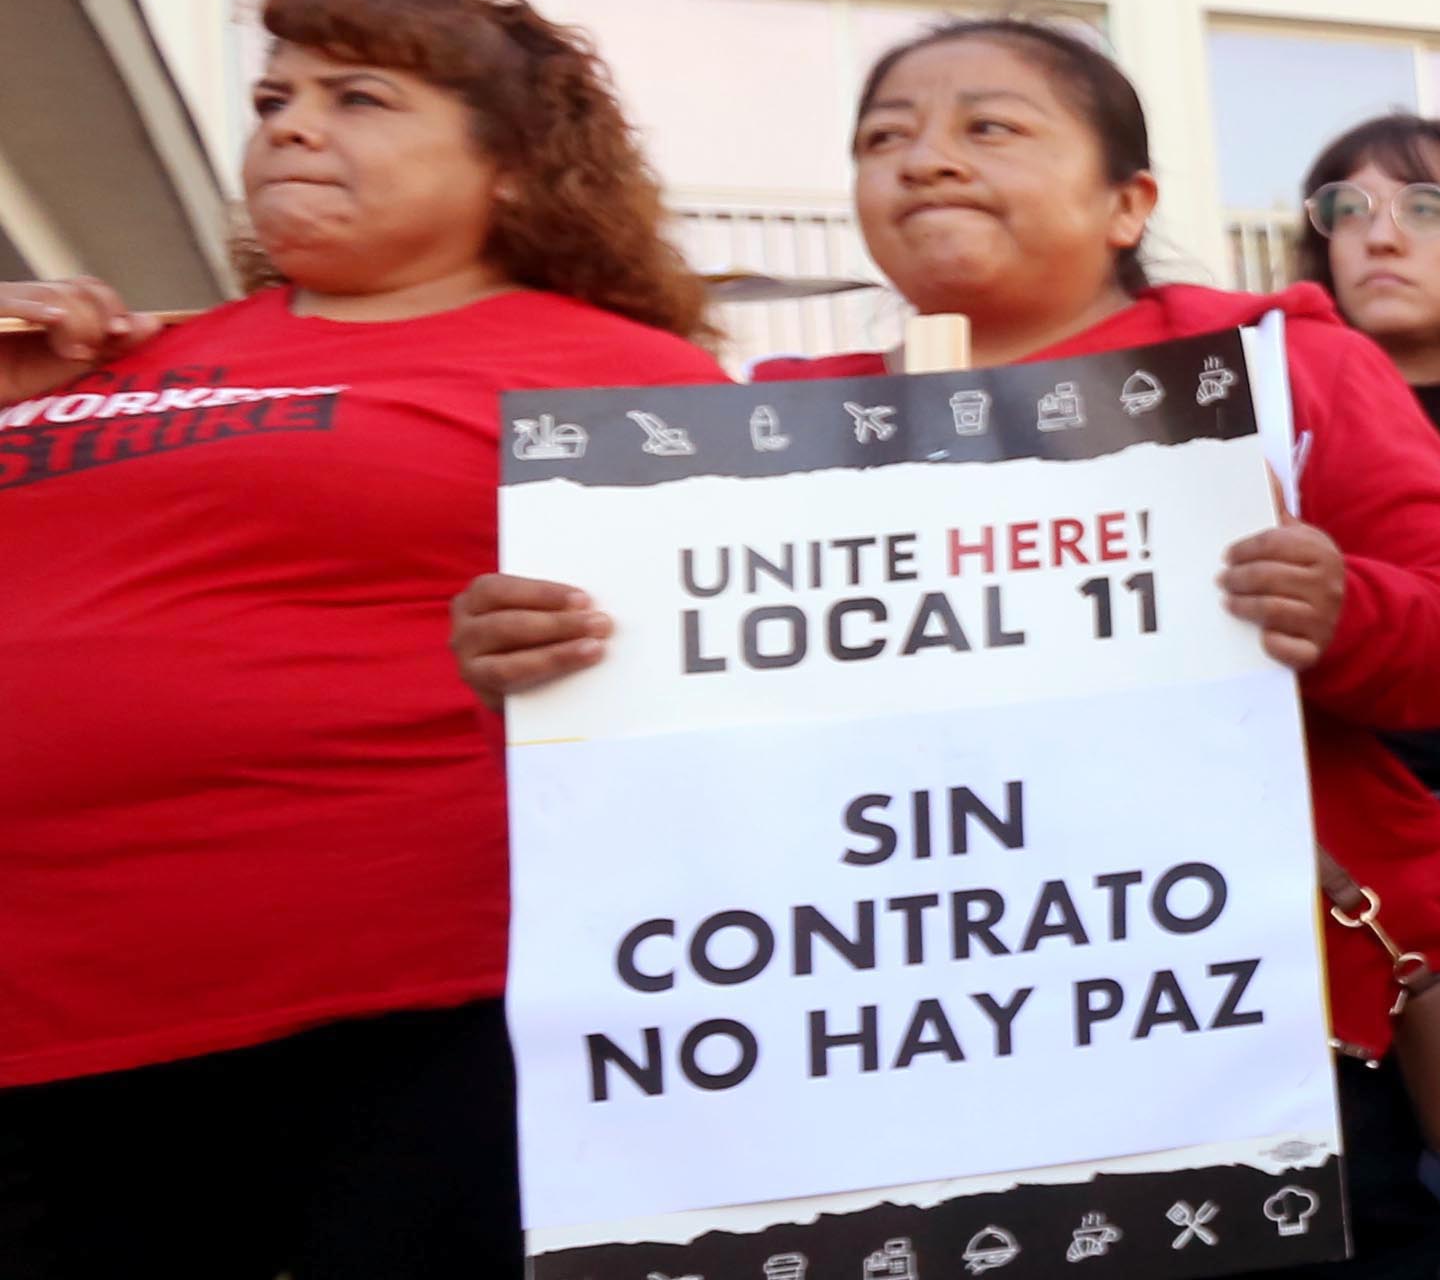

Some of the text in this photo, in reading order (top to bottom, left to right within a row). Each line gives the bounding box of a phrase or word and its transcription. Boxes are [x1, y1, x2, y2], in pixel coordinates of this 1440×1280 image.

[680, 510, 1151, 599] UNITE HERE!
[681, 571, 1161, 675] LOCAL 11
[841, 780, 1026, 867] SIN
[615, 861, 1228, 993] CONTRATO
[584, 958, 1265, 1103] NO HAY PAZ
